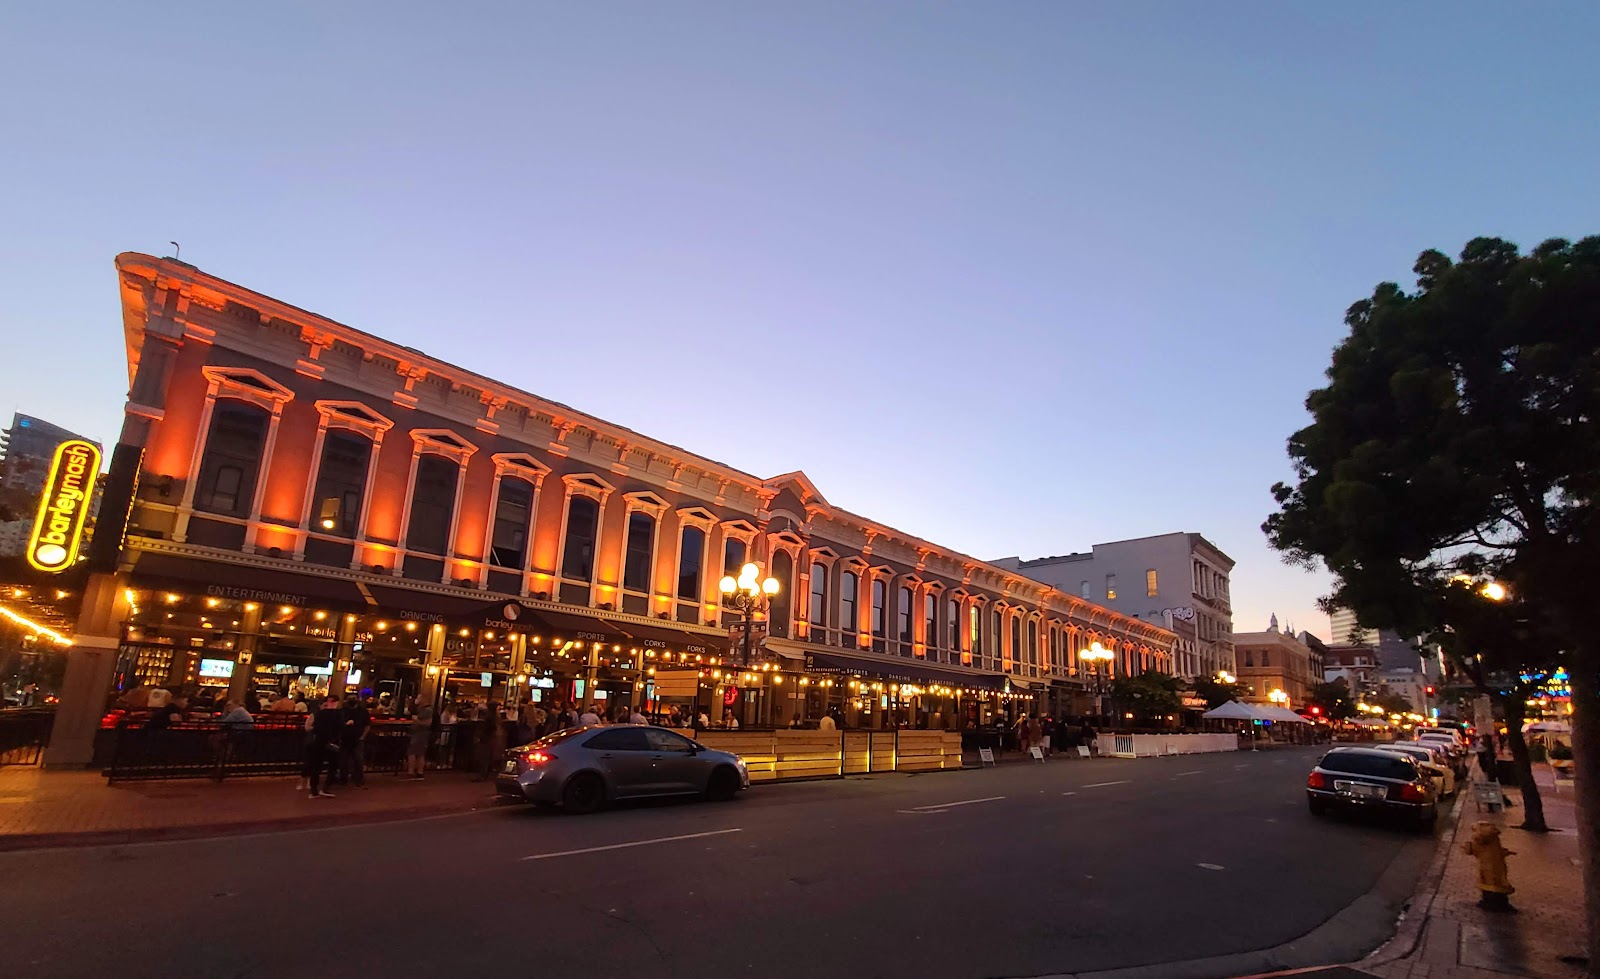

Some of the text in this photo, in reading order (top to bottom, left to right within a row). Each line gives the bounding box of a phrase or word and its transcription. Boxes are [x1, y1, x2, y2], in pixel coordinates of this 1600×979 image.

[39, 445, 90, 545] barleymash
[207, 585, 307, 605] ENTERTAINMENT
[400, 610, 443, 623] DANCING
[577, 631, 605, 641] SPORTS
[644, 639, 666, 648] CORKS
[687, 645, 706, 654] FORKS
[846, 668, 868, 676] SPORTS
[888, 673, 911, 682] DANCING
